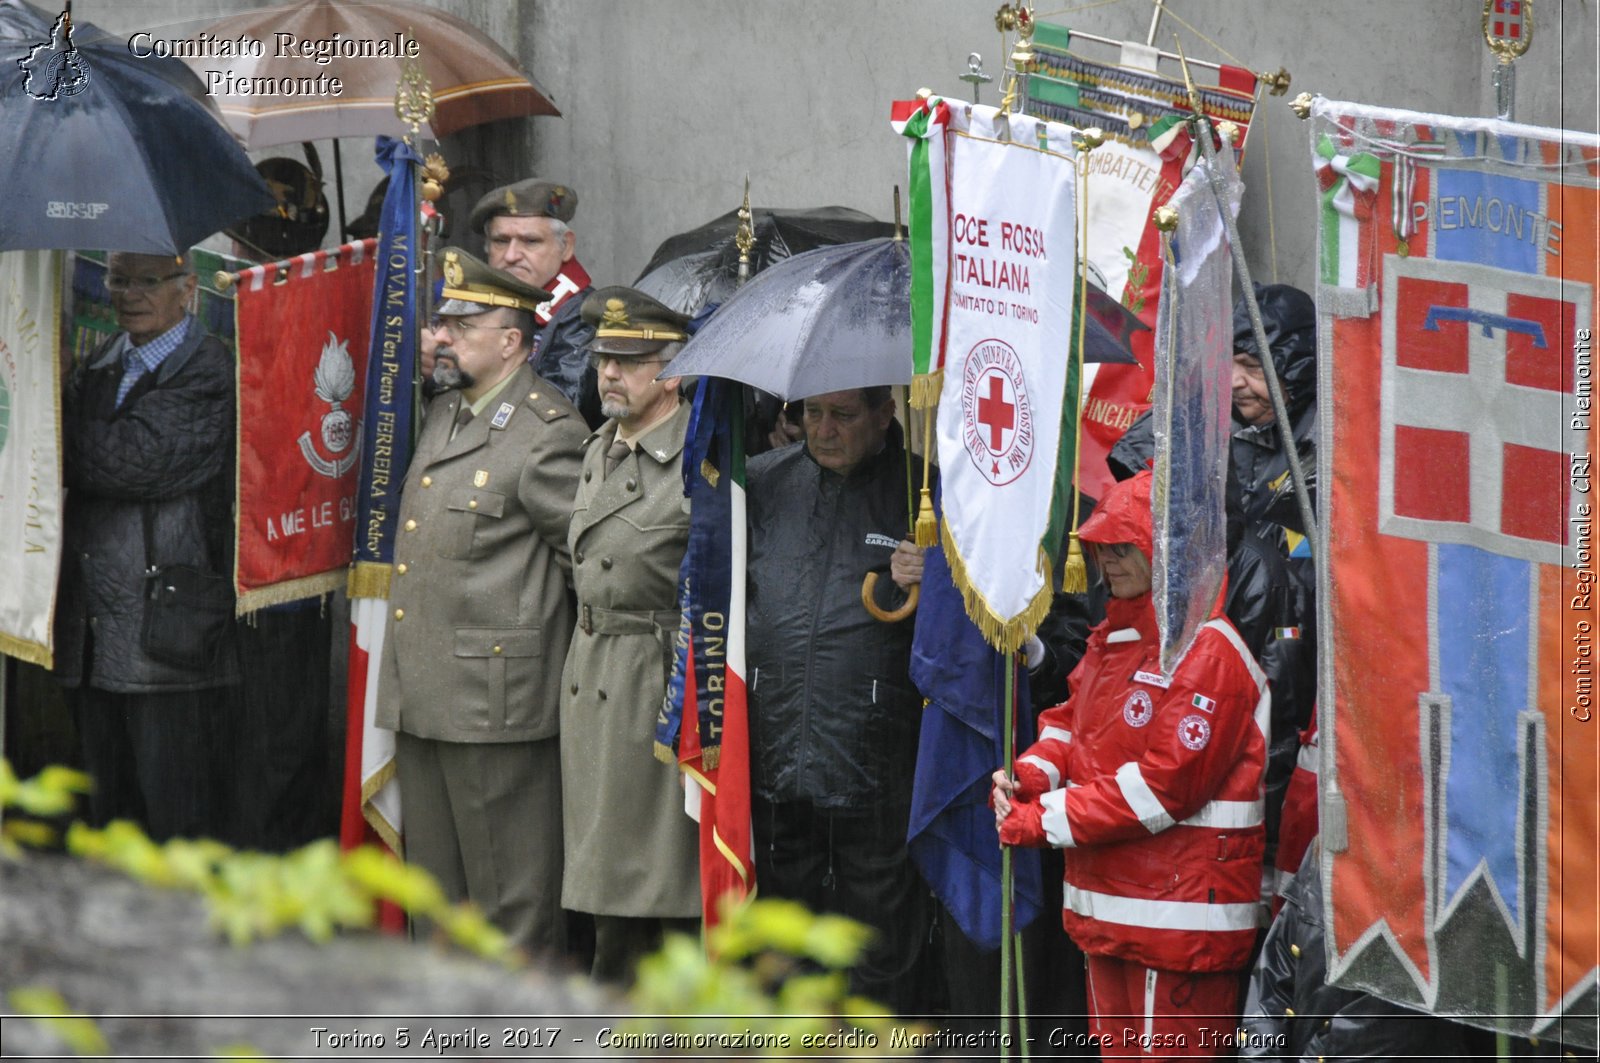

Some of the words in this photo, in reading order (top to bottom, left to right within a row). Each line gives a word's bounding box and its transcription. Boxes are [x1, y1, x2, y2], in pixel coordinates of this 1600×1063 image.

[46, 201, 109, 219] SKF
[1412, 196, 1562, 256] PIEMONTE
[1001, 221, 1047, 260] ROSSA
[954, 252, 1031, 296] ITALIANA
[998, 301, 1008, 317] DI
[1011, 303, 1039, 325] TORINO
[379, 362, 399, 405] Pietro
[982, 345, 1016, 377] GINEVRA
[1018, 393, 1031, 447] AGOSTO
[370, 411, 396, 498] FERREIRA
[267, 517, 279, 542] A
[281, 508, 306, 537] ME
[312, 501, 333, 528] LE
[702, 611, 725, 740] TORINO
